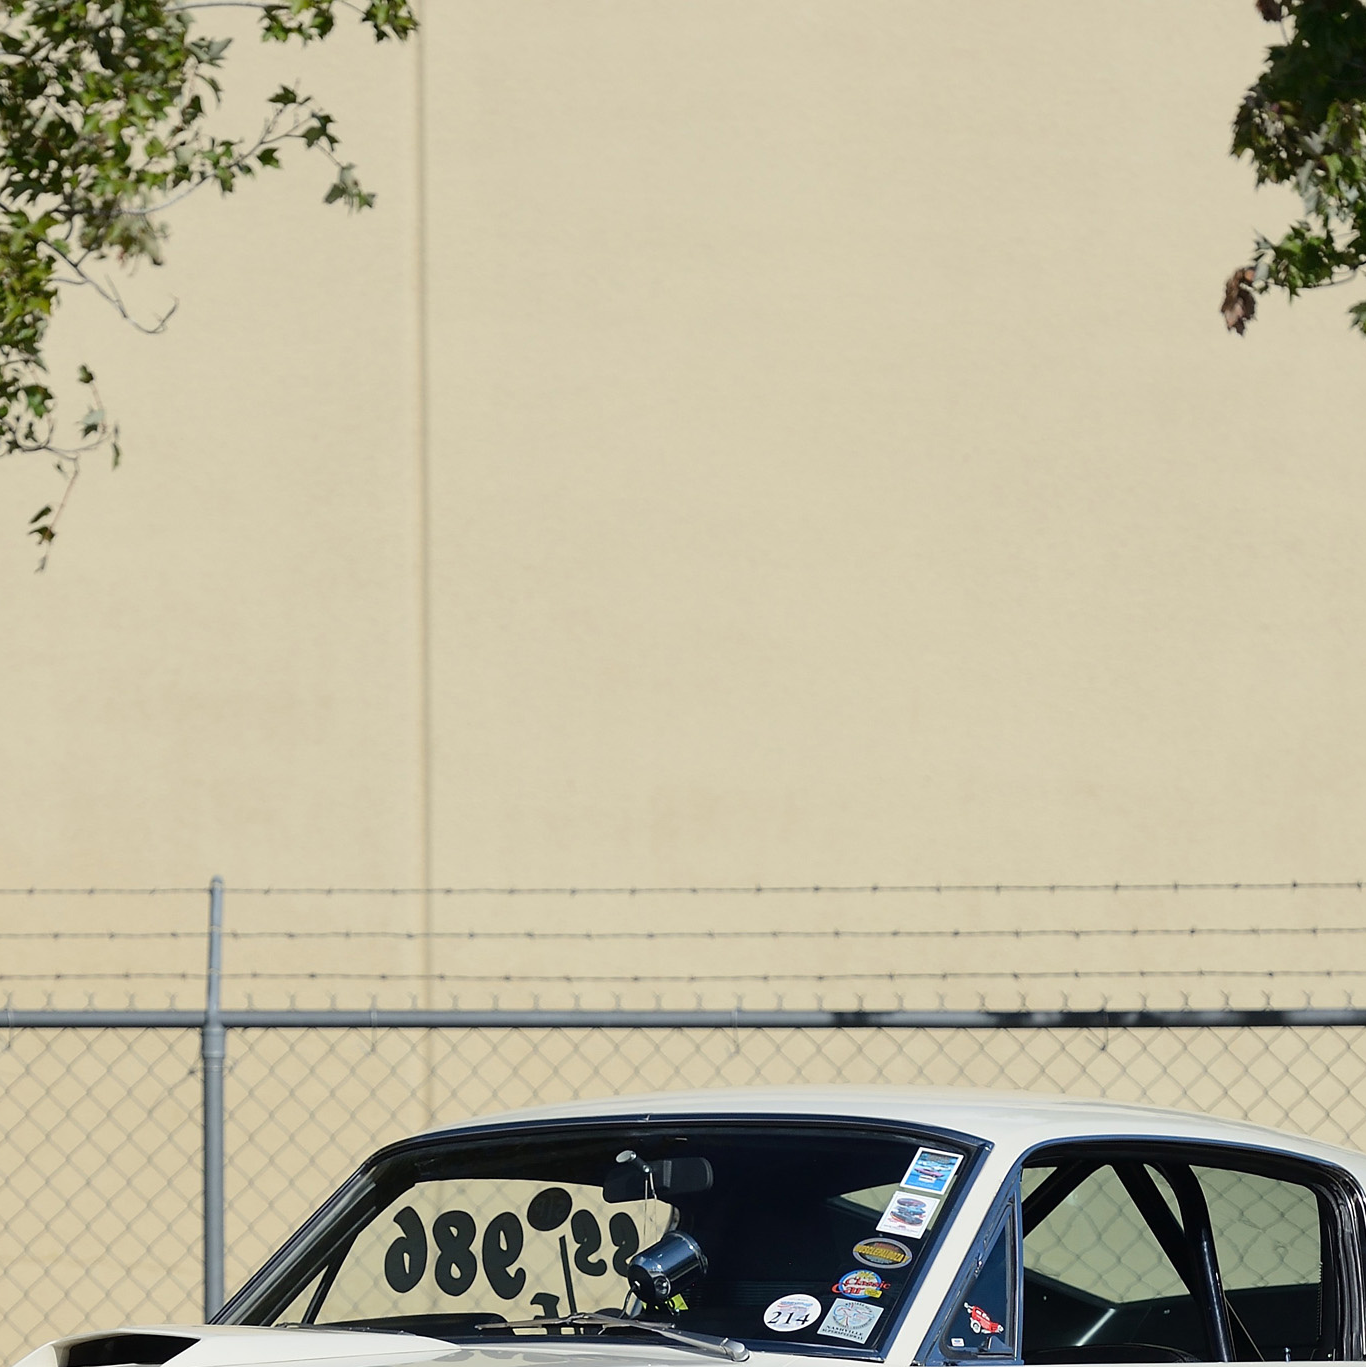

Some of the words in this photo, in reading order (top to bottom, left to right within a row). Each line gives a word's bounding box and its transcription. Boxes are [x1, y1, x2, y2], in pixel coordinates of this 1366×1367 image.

[831, 1282, 866, 1295] Car
[843, 1276, 891, 1290] Classic
[767, 1310, 811, 1326] 214
